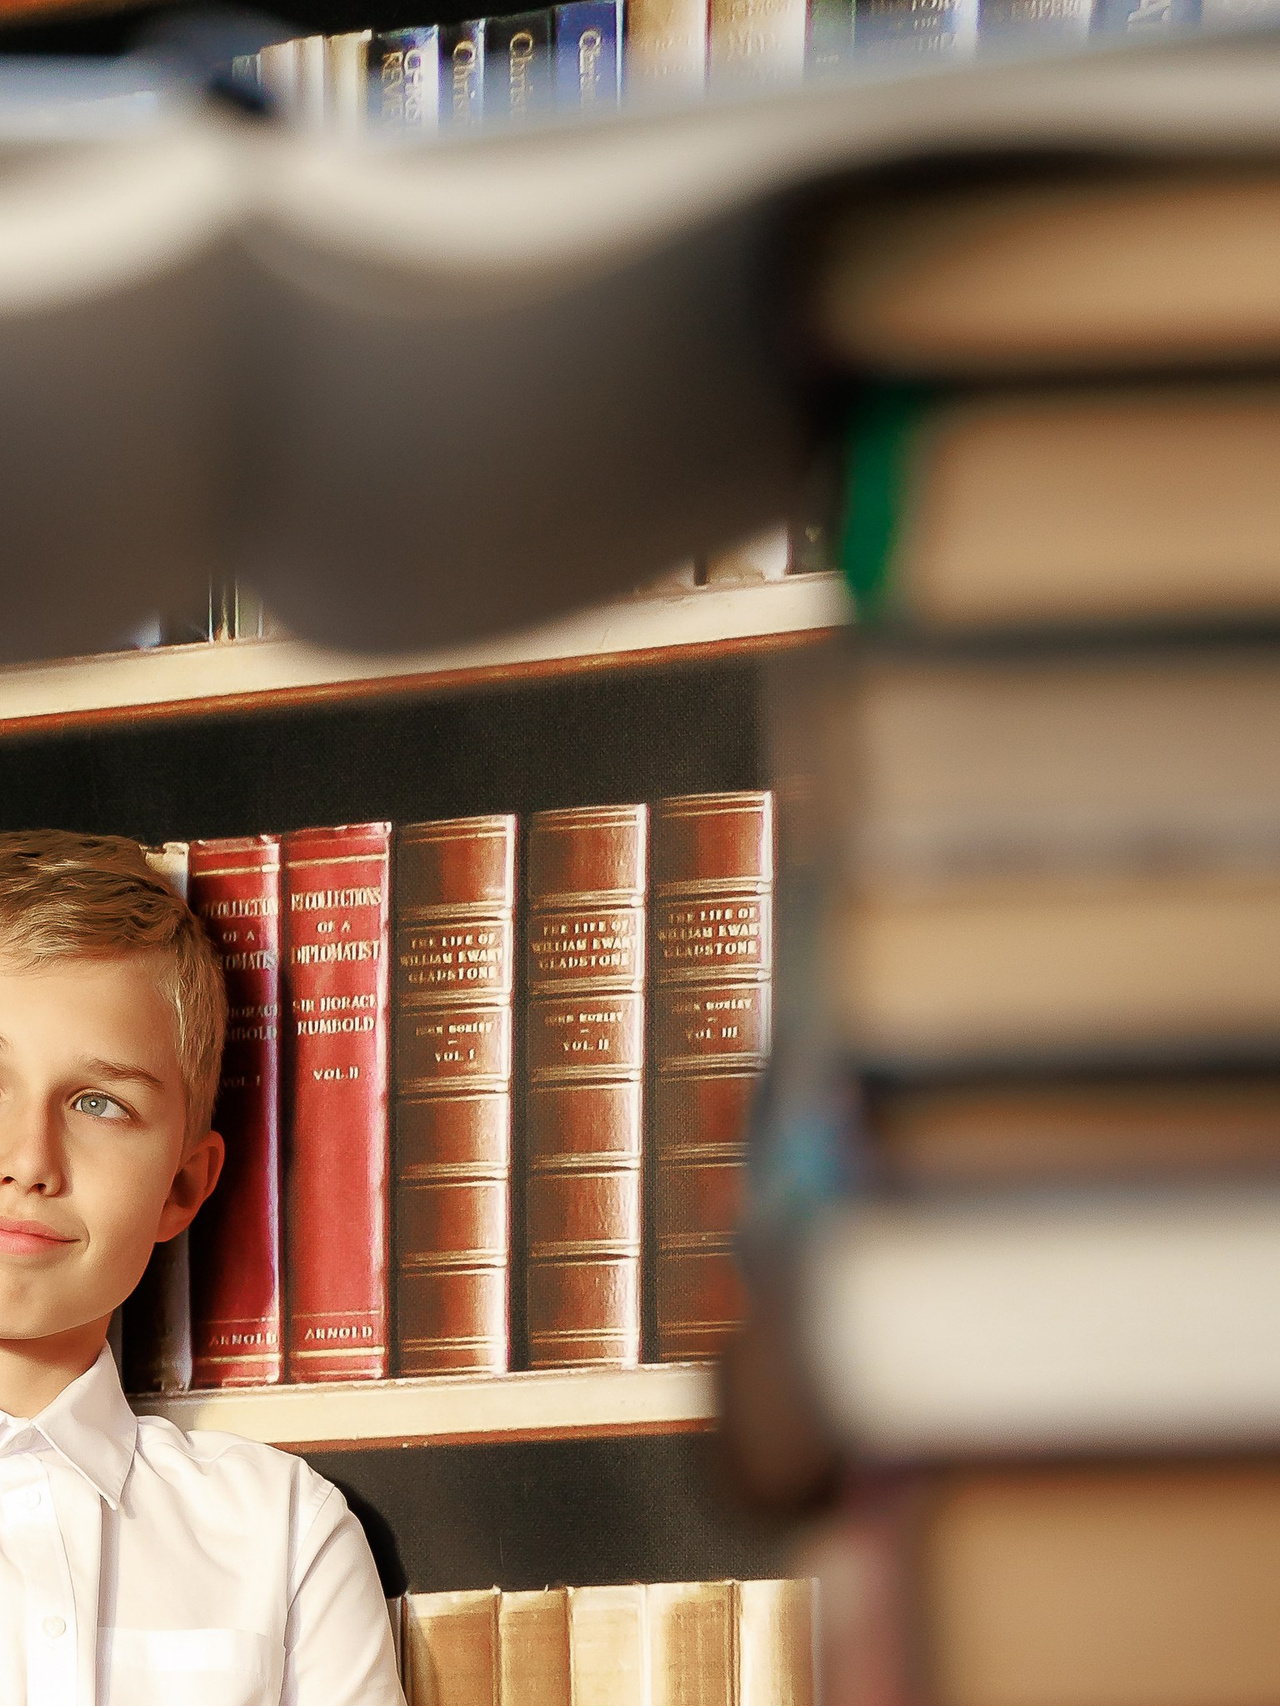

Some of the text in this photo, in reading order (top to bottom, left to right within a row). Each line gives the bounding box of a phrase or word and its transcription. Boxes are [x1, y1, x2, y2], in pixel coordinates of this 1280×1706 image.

[291, 886, 381, 912] RECOLLECTIONS
[700, 908, 734, 922] LIFE
[737, 906, 758, 919] OF
[317, 920, 352, 933] OF A
[574, 919, 607, 934] LIFE
[611, 918, 630, 932] OF
[441, 934, 474, 948] LIFE
[478, 932, 497, 945] OF
[531, 937, 587, 954] WILLIAM
[663, 940, 758, 957] GLADSTONE
[291, 939, 380, 965] DIPLOMATIST
[400, 951, 453, 968] WILLIAM
[539, 953, 630, 970] GLADSTONE
[408, 965, 498, 984] GLADSTONE
[320, 994, 376, 1013] HORACE
[297, 1016, 376, 1036] RUMBOLD
[209, 1332, 278, 1347] ARNOLD
[304, 1325, 373, 1341] ARNOLD
